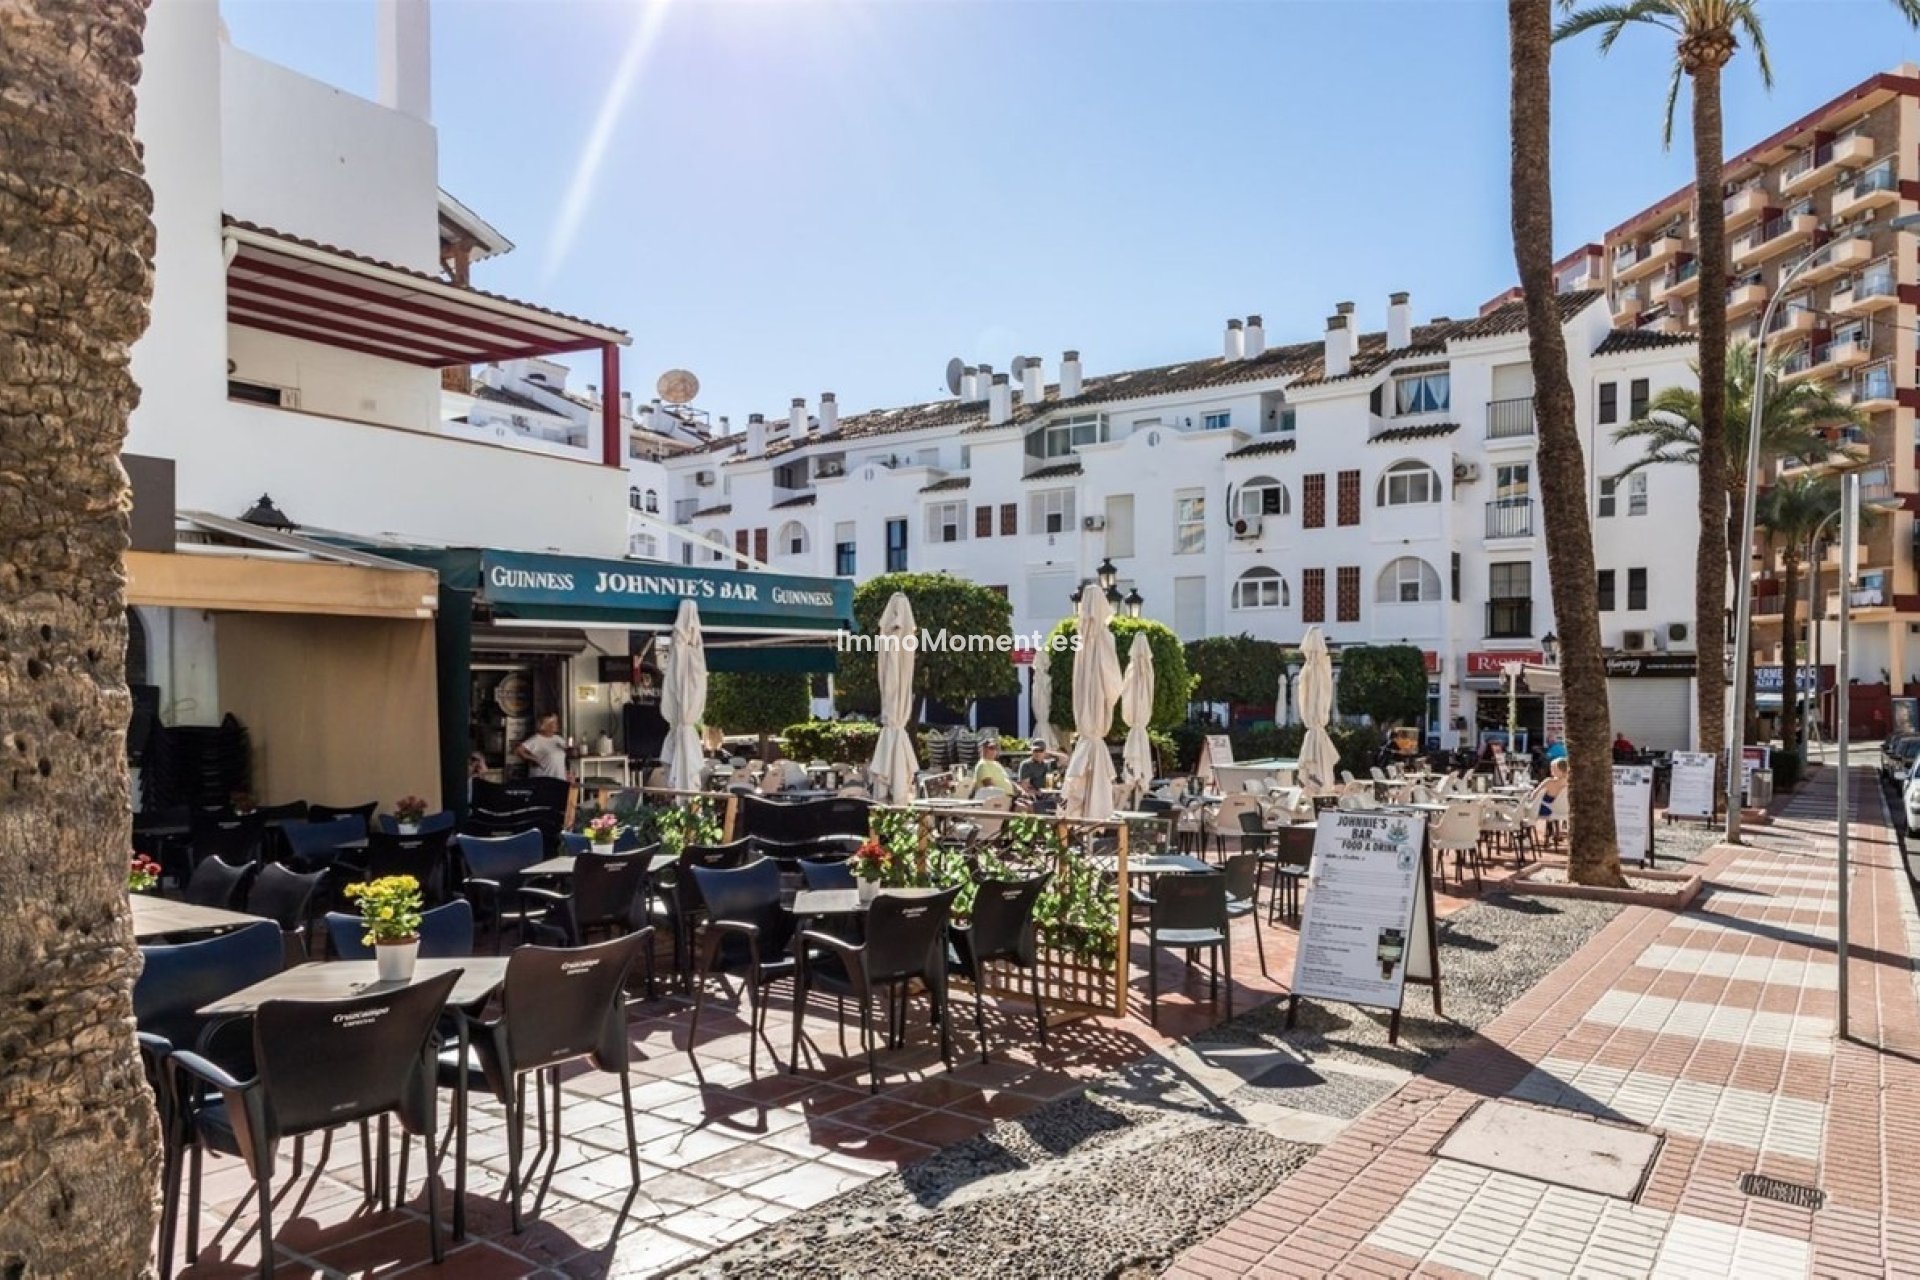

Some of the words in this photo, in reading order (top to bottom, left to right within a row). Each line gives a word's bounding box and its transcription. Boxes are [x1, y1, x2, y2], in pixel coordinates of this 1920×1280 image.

[491, 566, 575, 591] GUINNESS
[720, 582, 758, 600] BAR
[1336, 816, 1388, 829] JOHNNIE'S
[1351, 828, 1373, 839] BAR
[1341, 840, 1363, 850] FOOD
